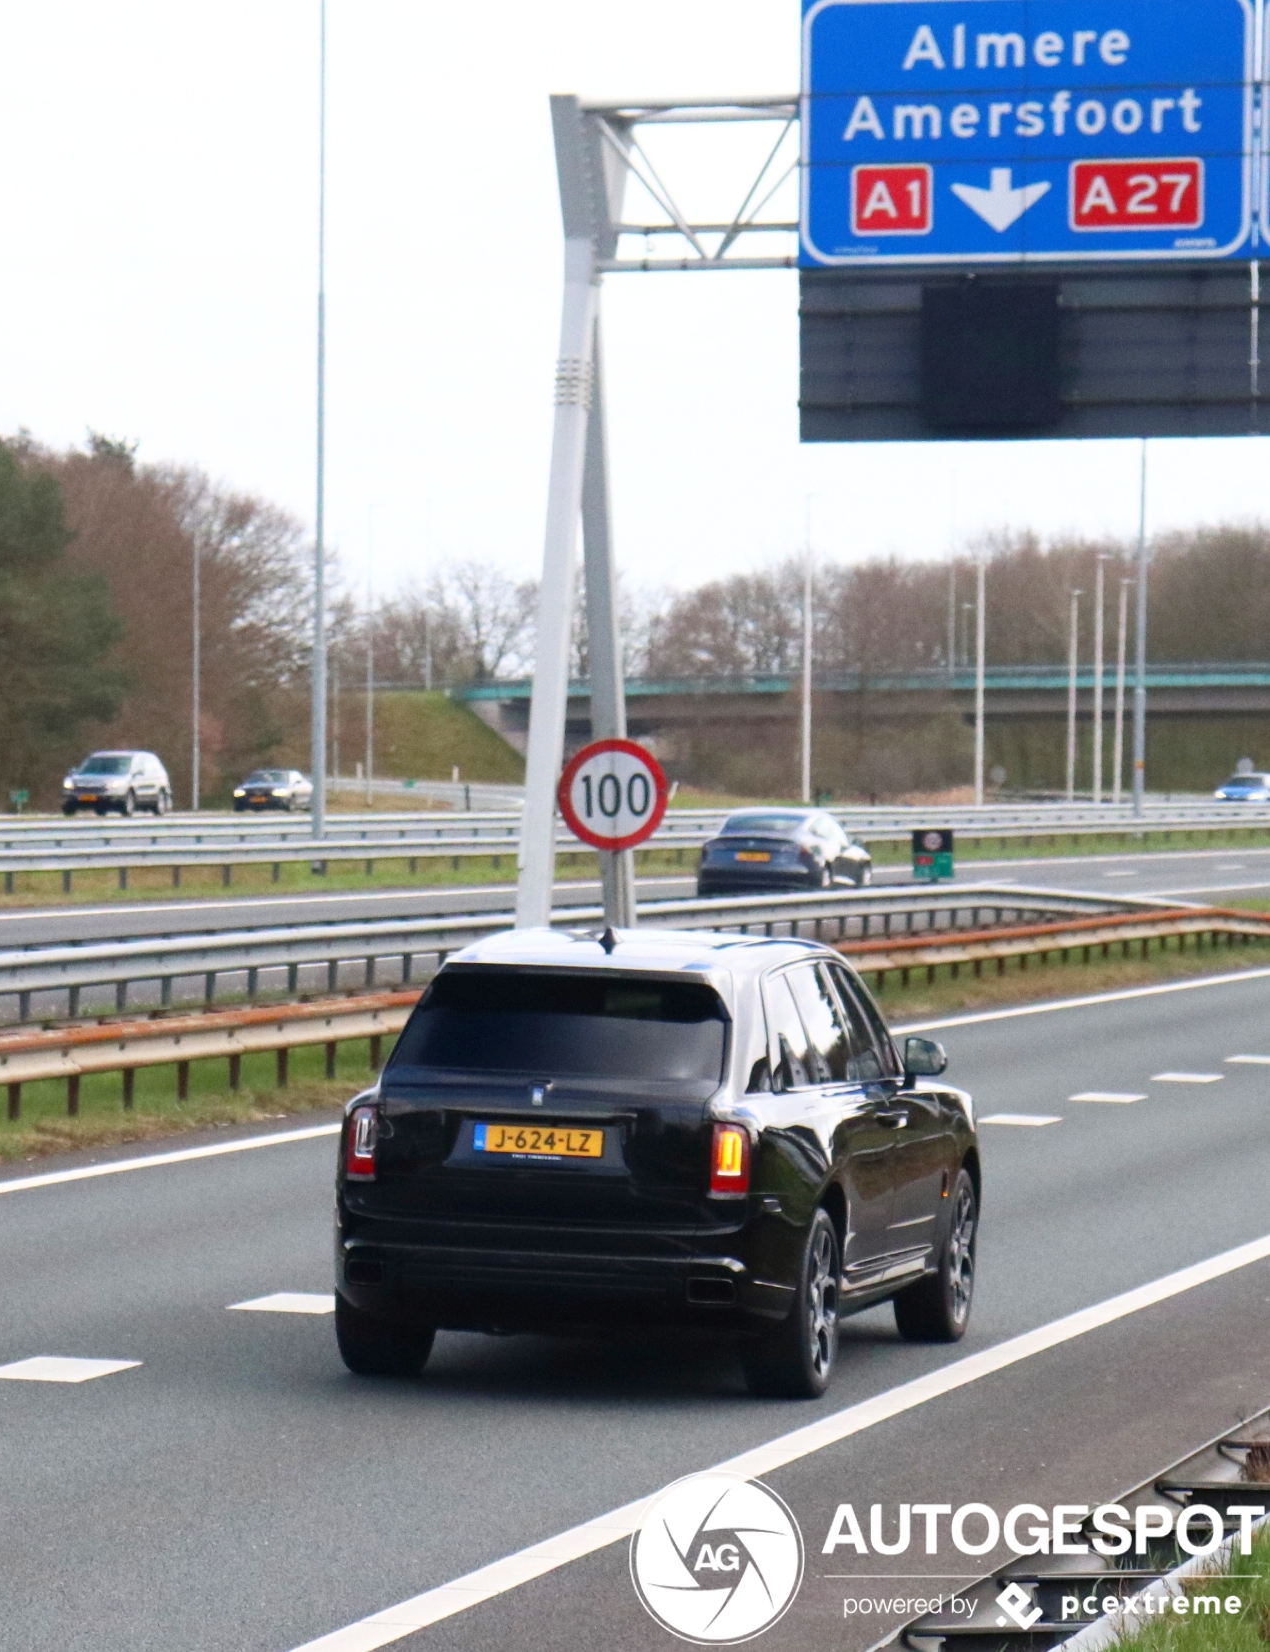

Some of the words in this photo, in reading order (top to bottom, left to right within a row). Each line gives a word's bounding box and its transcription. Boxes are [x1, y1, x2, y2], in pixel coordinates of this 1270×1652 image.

[902, 22, 1130, 71] Almere
[842, 88, 1203, 141] Amersfoort
[862, 180, 921, 219] A1
[1080, 174, 1192, 215] A27
[582, 772, 650, 818] 100
[495, 1128, 591, 1153] J-624-LZ
